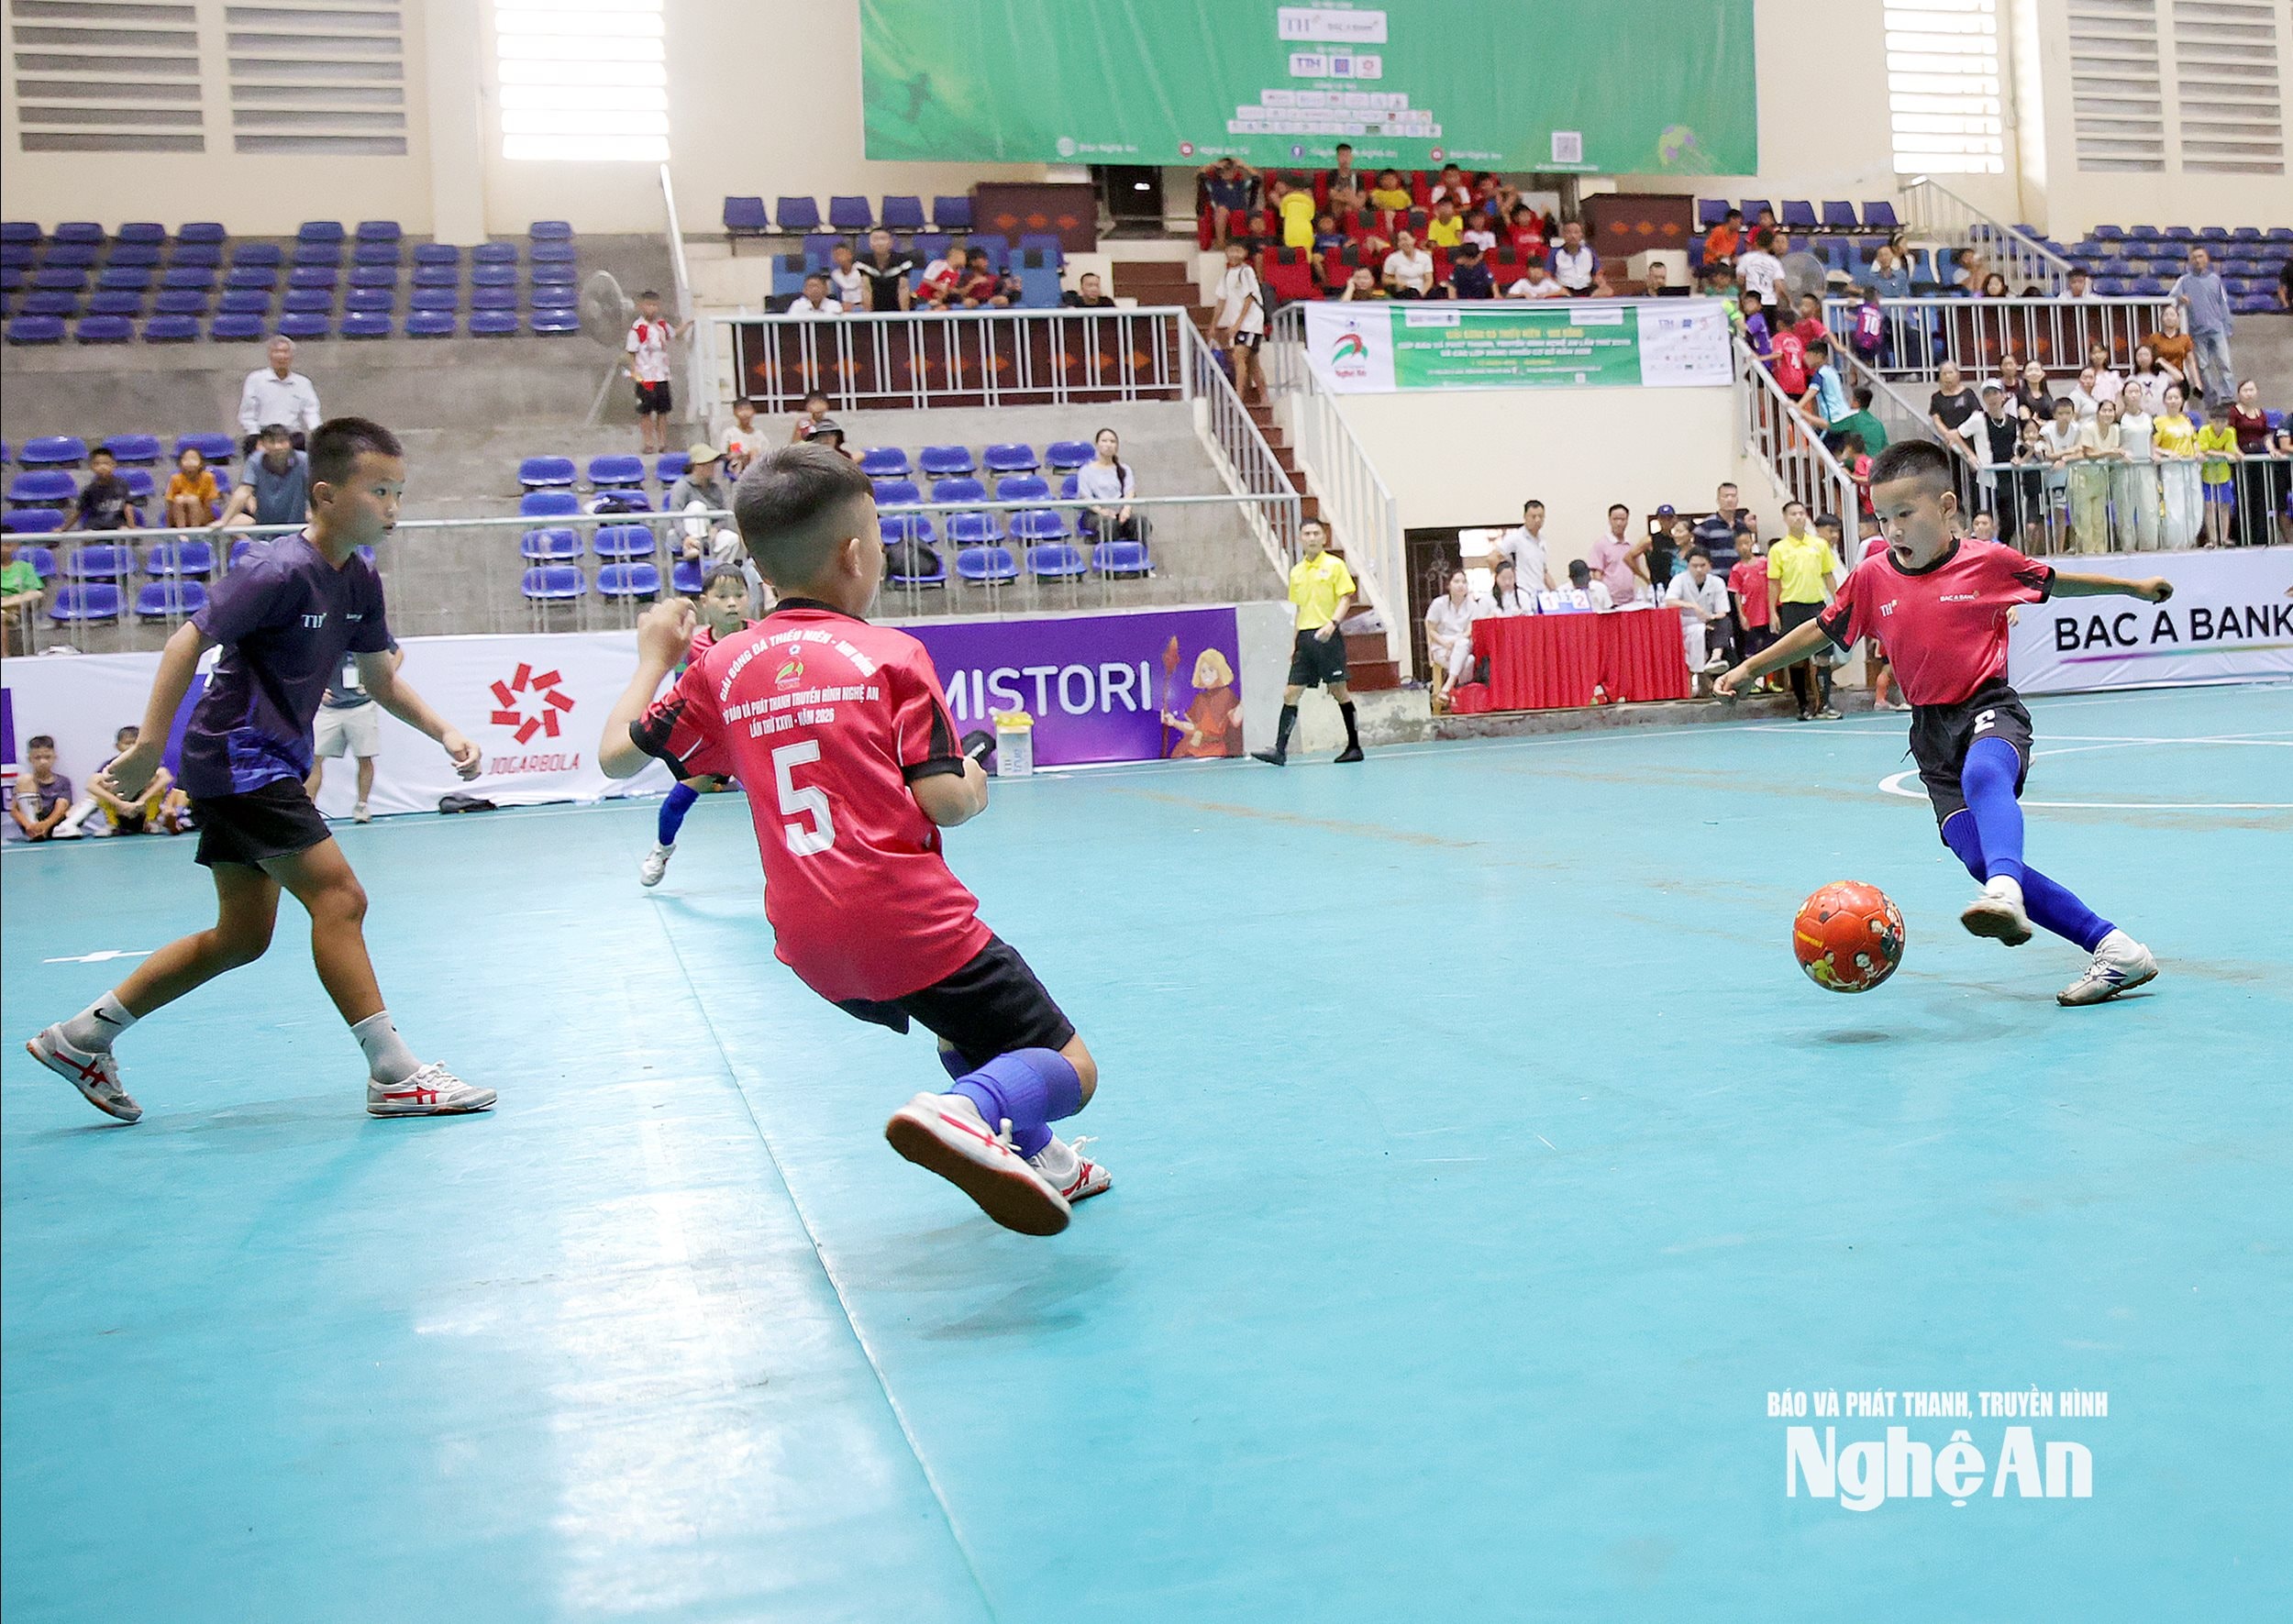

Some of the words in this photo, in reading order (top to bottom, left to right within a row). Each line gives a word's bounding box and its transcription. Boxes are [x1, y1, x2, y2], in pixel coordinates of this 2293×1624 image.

[1864, 314, 1880, 336] 10
[2055, 613, 2139, 652] BAC
[2150, 610, 2179, 644] A
[2189, 603, 2293, 641] BANK
[866, 686, 880, 702] AN
[487, 753, 580, 776] JOGARBOLA
[770, 739, 836, 857] 5
